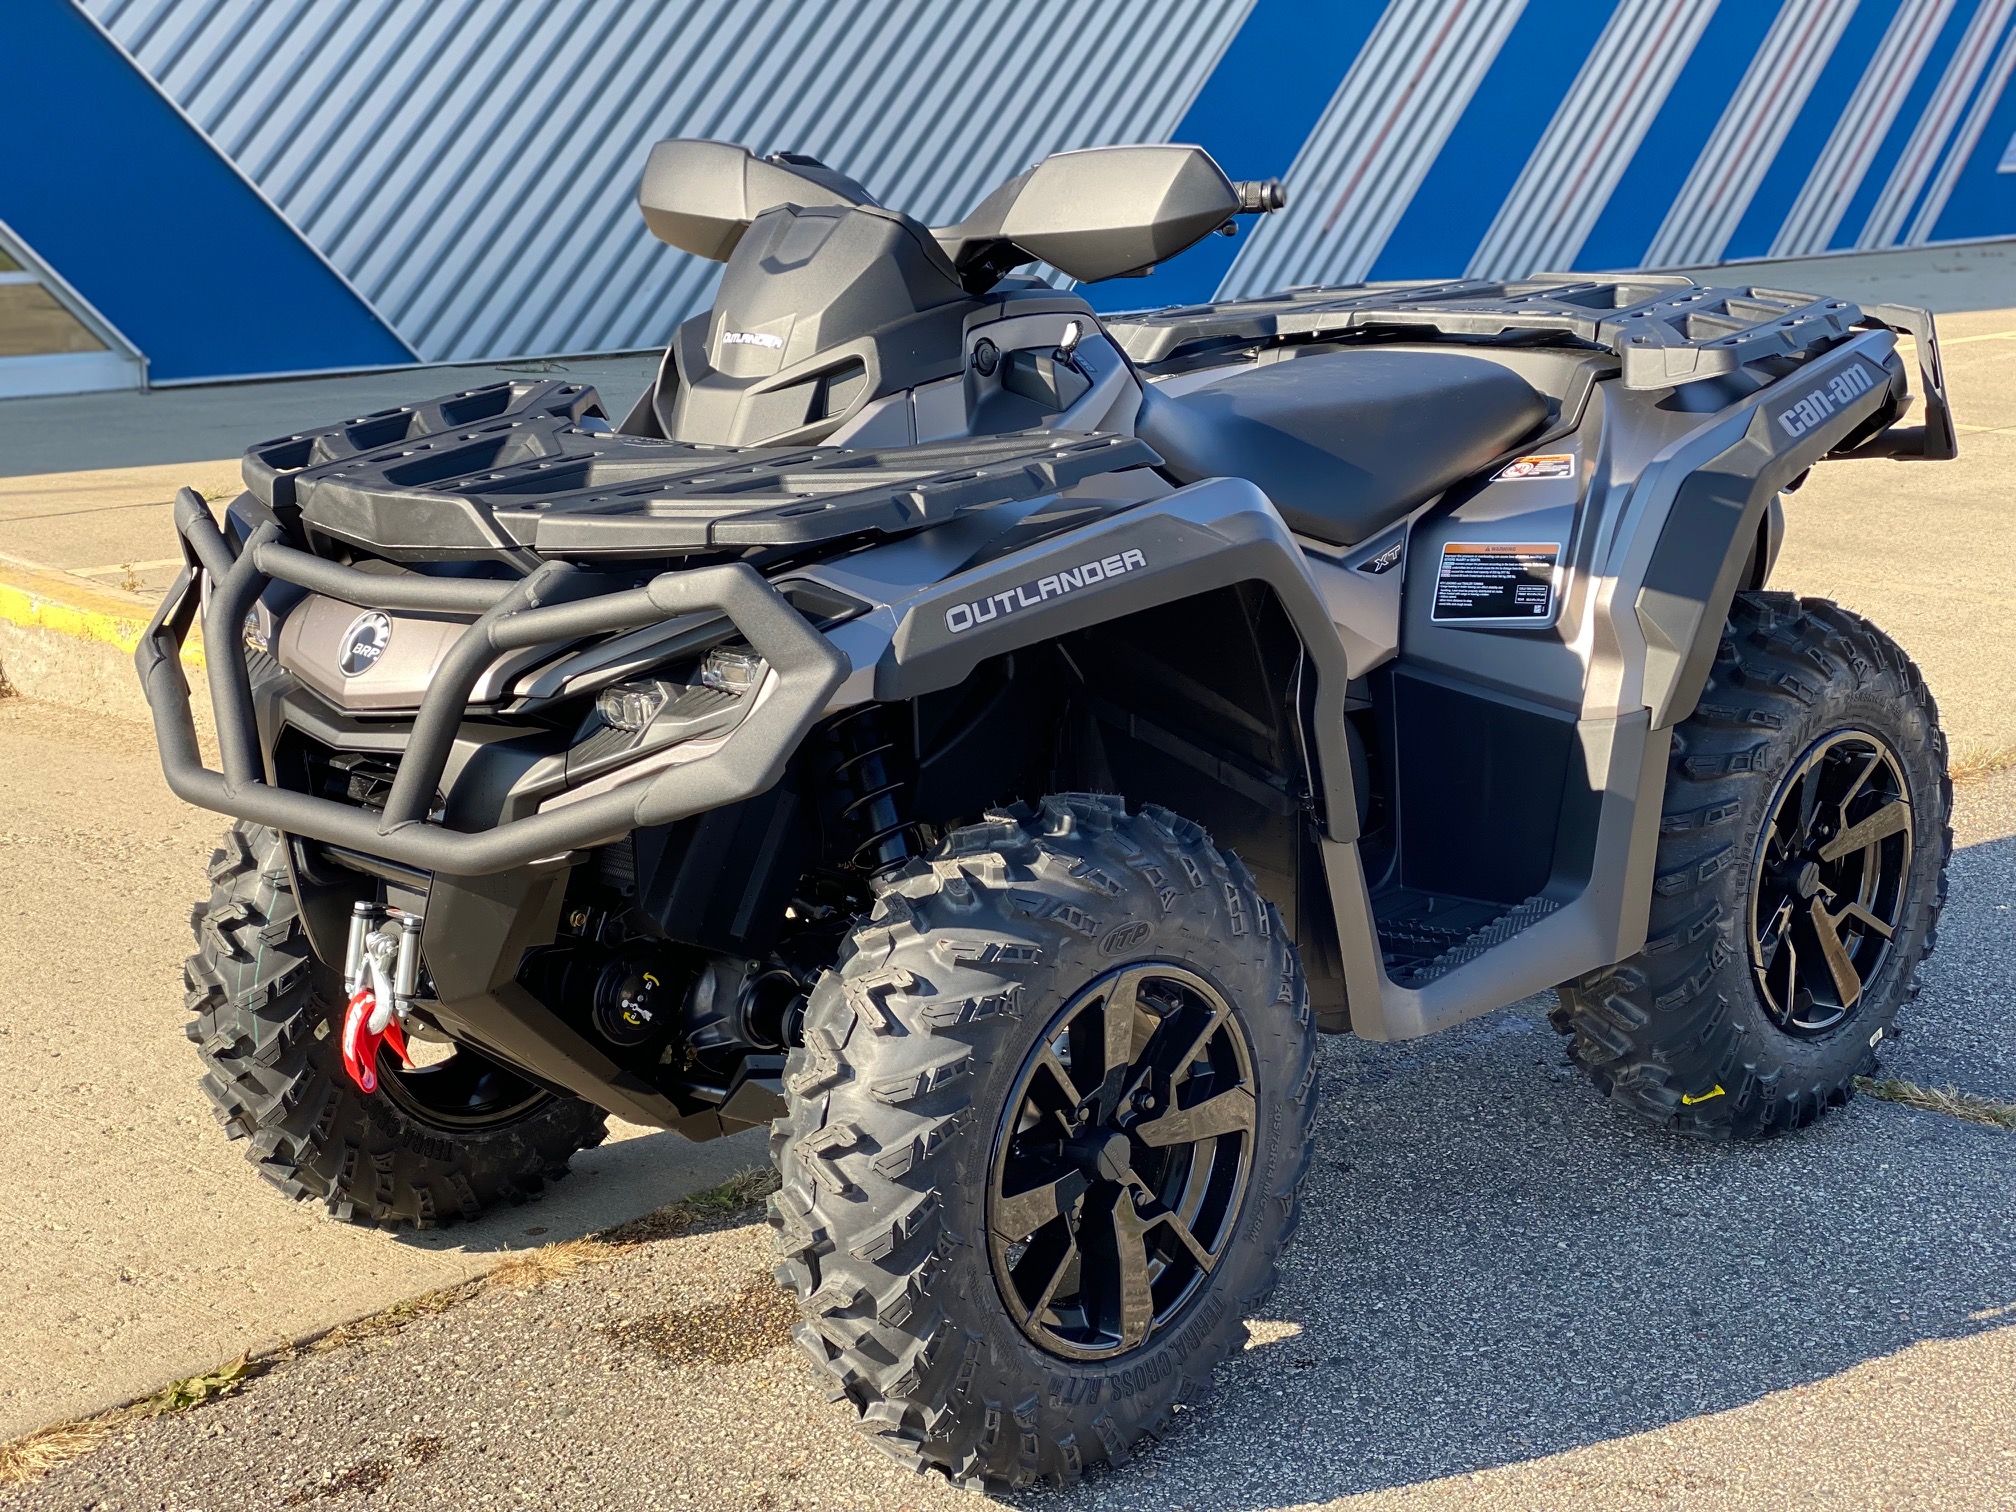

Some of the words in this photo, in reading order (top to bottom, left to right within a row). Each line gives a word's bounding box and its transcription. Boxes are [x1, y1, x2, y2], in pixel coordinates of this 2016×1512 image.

[723, 331, 783, 349] OUTLANDER
[1777, 362, 1875, 438] can-am
[1374, 544, 1401, 572] XT
[945, 548, 1147, 634] OUTLANDER
[352, 642, 381, 658] BRP
[1103, 921, 1150, 953] ITP
[1266, 1103, 1283, 1179] 205/75R14
[1260, 1181, 1272, 1209] M/C
[1250, 1211, 1265, 1244] 48M
[1171, 1293, 1228, 1367] TERRA
[1109, 1350, 1172, 1403] CROSS
